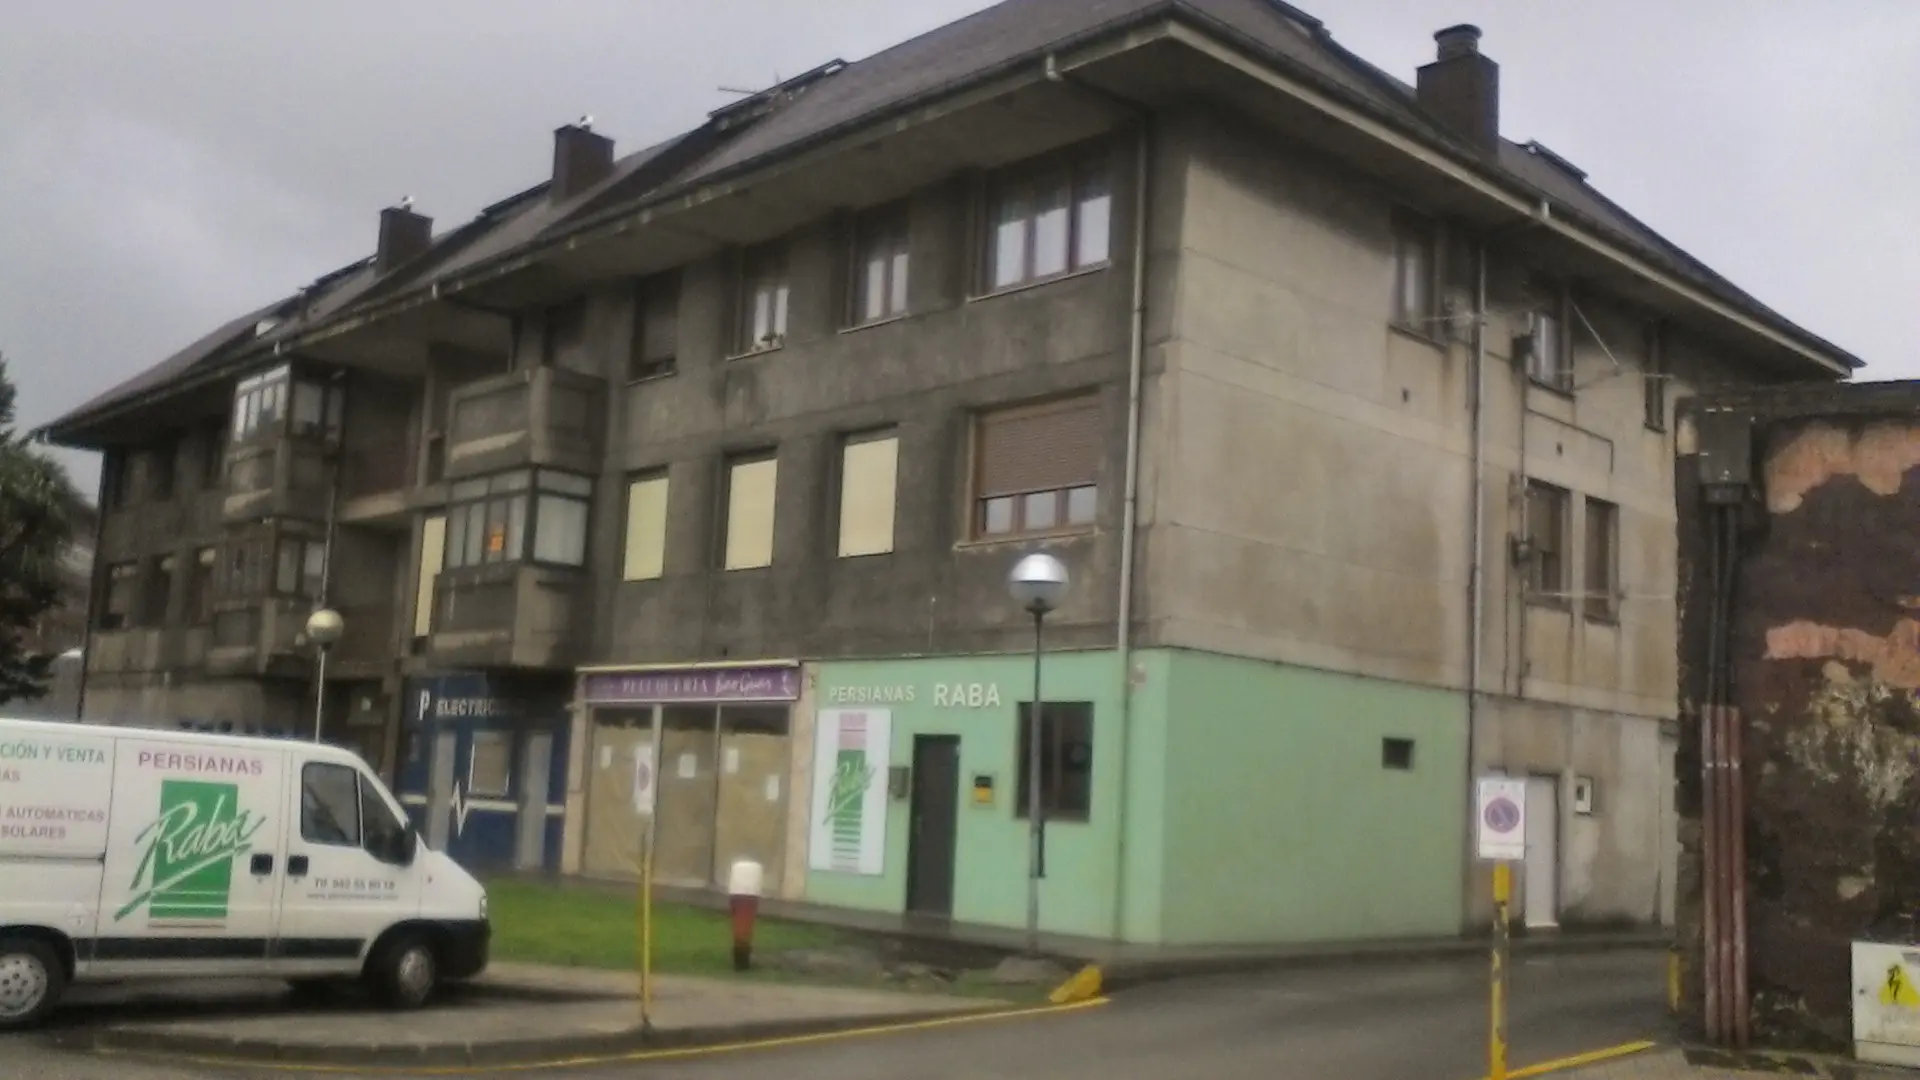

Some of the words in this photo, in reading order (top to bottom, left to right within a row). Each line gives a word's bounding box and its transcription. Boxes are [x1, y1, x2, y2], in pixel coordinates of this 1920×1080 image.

[829, 684, 915, 702] PERSIANAS
[934, 682, 1001, 708] RABA
[435, 697, 522, 717] ELECTRIC
[43, 745, 52, 760] Y
[57, 746, 105, 764] VENTA
[138, 751, 264, 776] PERSIANAS
[0, 767, 20, 781] AS
[130, 794, 267, 890] Raba
